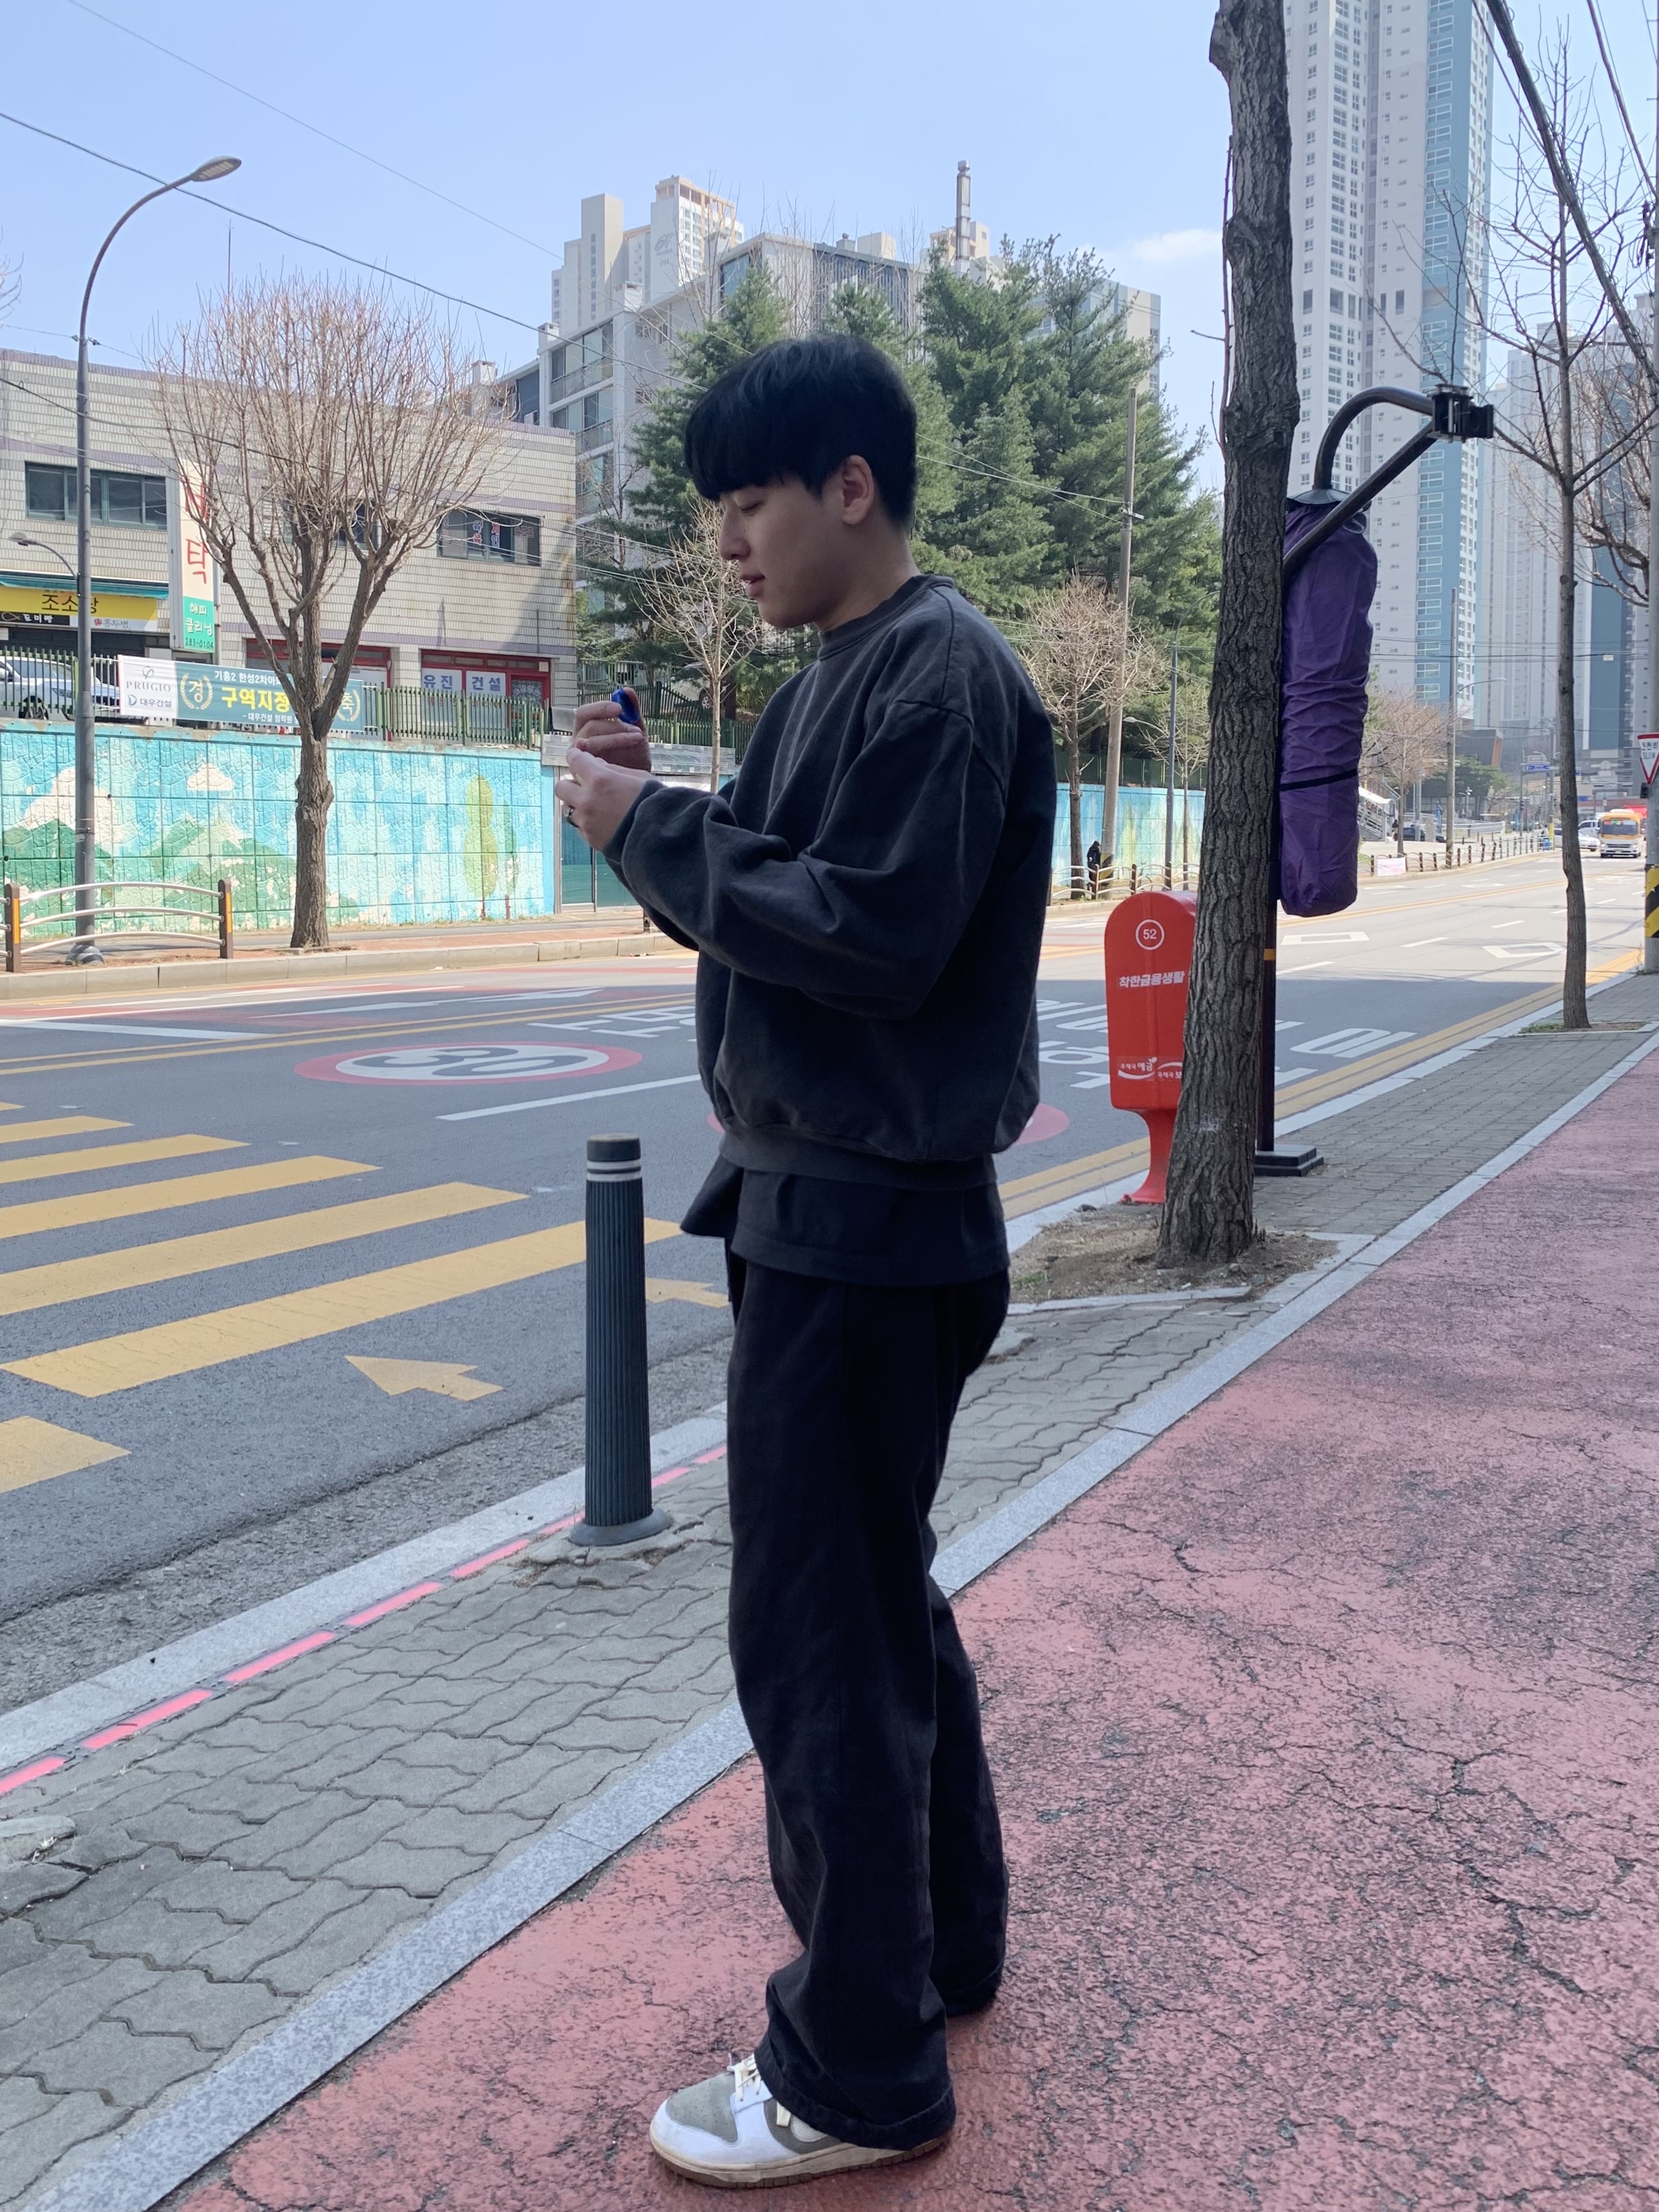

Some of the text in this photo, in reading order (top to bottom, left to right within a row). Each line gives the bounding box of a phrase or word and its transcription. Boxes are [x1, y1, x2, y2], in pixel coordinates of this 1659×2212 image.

[190, 603, 207, 616] 해피
[186, 618, 212, 636] 클리닝
[185, 638, 213, 648] 283-0104
[215, 670, 281, 685] 기흥2 한성2차아
[424, 674, 453, 689] 유진
[472, 677, 501, 691] 건설
[126, 681, 171, 692] PRUGIO
[189, 680, 203, 703] 경
[140, 699, 172, 708] 대우건설
[222, 687, 290, 713] 구역지정
[341, 693, 354, 715] 축
[248, 713, 272, 722] 대우건설
[275, 715, 292, 723] 임직원
[1143, 928, 1157, 940] 52
[1119, 971, 1185, 988] 착한금융생활
[1137, 1062, 1153, 1071] 예금
